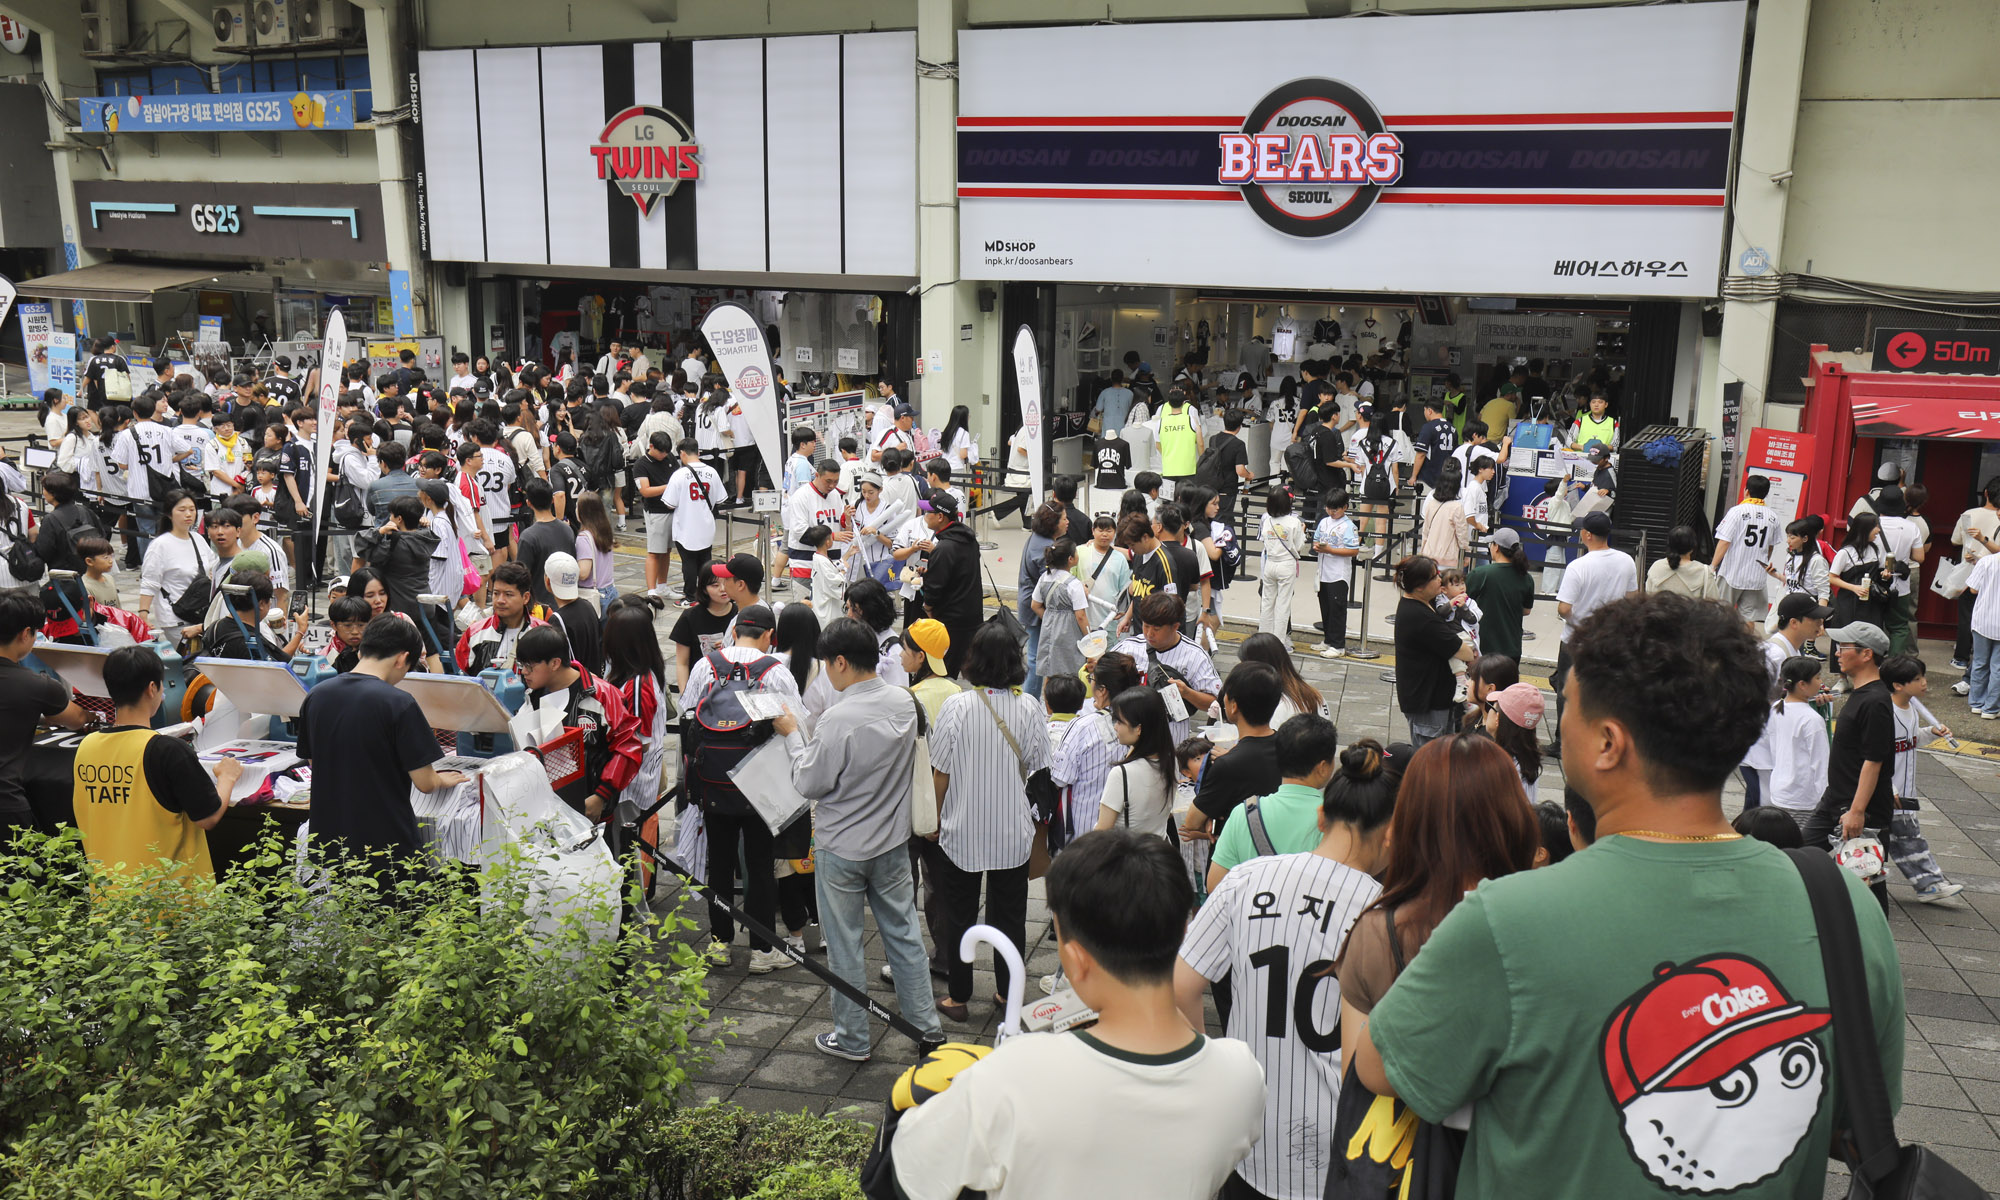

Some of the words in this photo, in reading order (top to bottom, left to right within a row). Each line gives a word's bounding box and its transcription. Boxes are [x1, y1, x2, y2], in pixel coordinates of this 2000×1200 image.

[143, 103, 190, 123] 잠실야구장
[191, 103, 212, 123] 대표
[213, 102, 243, 122] 편의점
[245, 101, 281, 122] GS25
[1276, 116, 1347, 127] DOOSAN
[635, 125, 655, 141] LG
[590, 145, 700, 179] TWINS
[1218, 133, 1404, 186] BEARS
[1288, 191, 1332, 203] SEOUL
[190, 203, 240, 233] GS25
[985, 257, 1073, 266] inpk.kr/doosanbears
[1553, 260, 1688, 277] 베어스하우스
[24, 305, 46, 313] GS25
[27, 316, 47, 324] 시원한
[54, 336, 69, 344] GS25
[1934, 341, 1990, 362] 50m
[51, 364, 74, 384] 맥주
[477, 471, 504, 492] 23
[1744, 525, 1768, 548] 51
[77, 764, 134, 784] GOODS
[85, 785, 131, 804] TAFF
[1249, 945, 1341, 1053] 10
[1702, 985, 1769, 1026] Coke
[1032, 1004, 1063, 1020] TWINS
[1681, 1004, 1701, 1019] Enjoy
